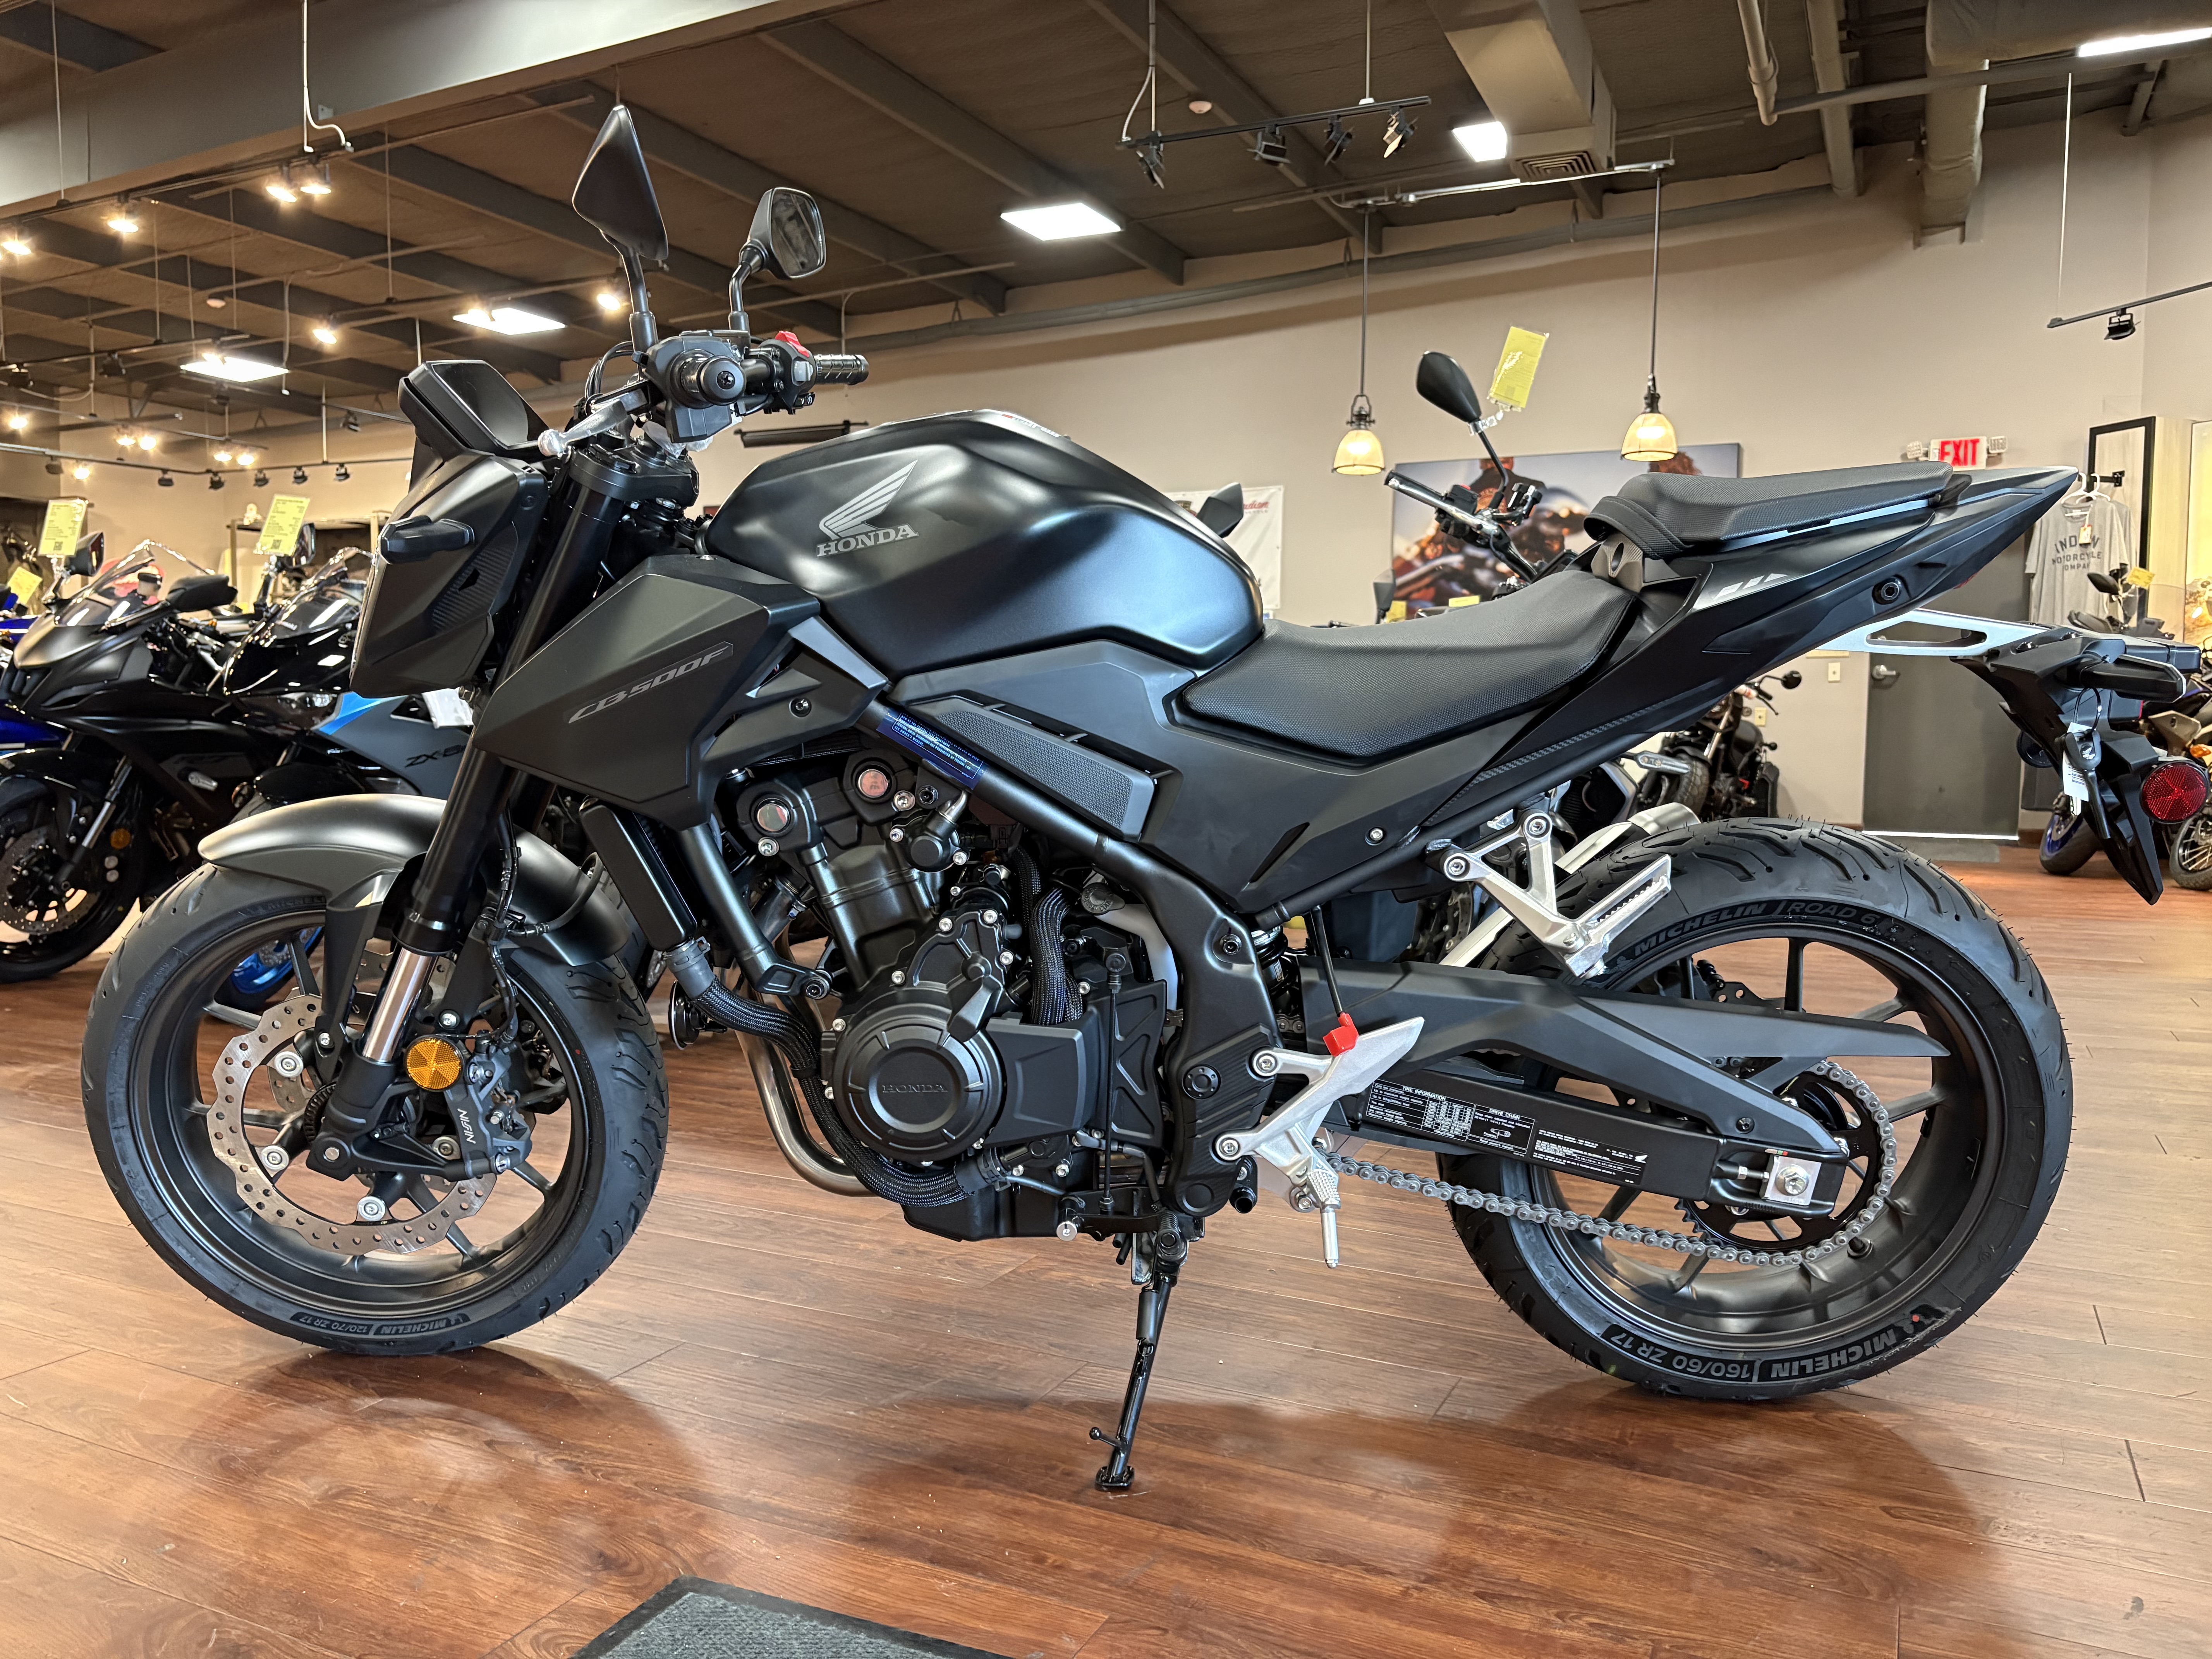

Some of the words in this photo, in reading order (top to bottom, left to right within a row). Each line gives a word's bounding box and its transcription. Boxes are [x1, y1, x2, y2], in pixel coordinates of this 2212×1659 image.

[1939, 438, 1980, 466] EXIT
[817, 524, 919, 557] HONDA
[2054, 535, 2100, 554] INDN
[2052, 551, 2102, 565] OORCYLE
[2063, 563, 2090, 571] OMPA
[568, 646, 729, 724] CB500F
[1635, 902, 1767, 957] MICHELIN
[1786, 902, 1857, 919] ROAD
[1860, 913, 1881, 924] 6
[882, 1085, 948, 1093] HONDA
[1415, 1089, 1446, 1101] INFORMATION
[313, 1318, 330, 1328] ZR
[331, 1322, 368, 1333] 120/70
[380, 1319, 447, 1334] MICHELIN
[1611, 1333, 1634, 1349] 17
[1637, 1342, 1668, 1363] ZR
[1771, 1329, 1897, 1378] MICHELIN
[1672, 1355, 1750, 1379] 160/60
